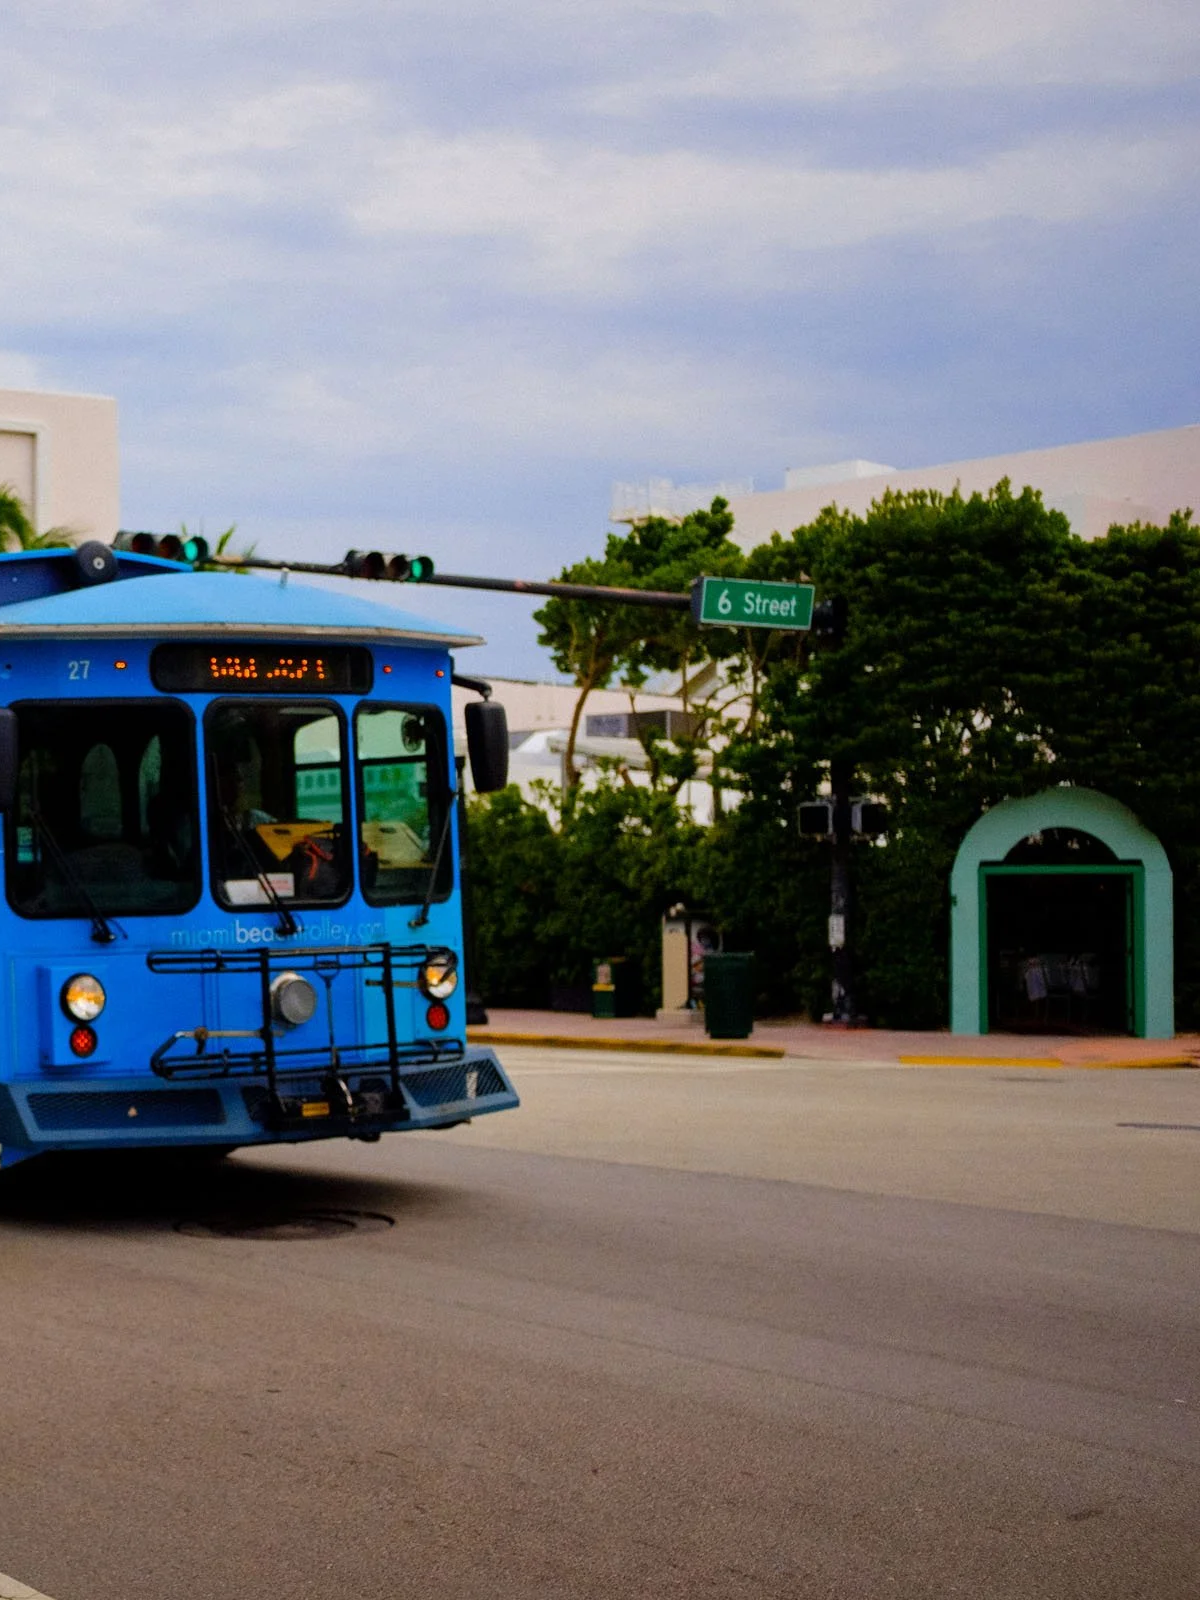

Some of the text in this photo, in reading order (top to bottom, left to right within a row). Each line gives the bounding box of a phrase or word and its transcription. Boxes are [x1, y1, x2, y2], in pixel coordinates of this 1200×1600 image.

[718, 589, 797, 617] 6 Street
[68, 660, 90, 680] 27
